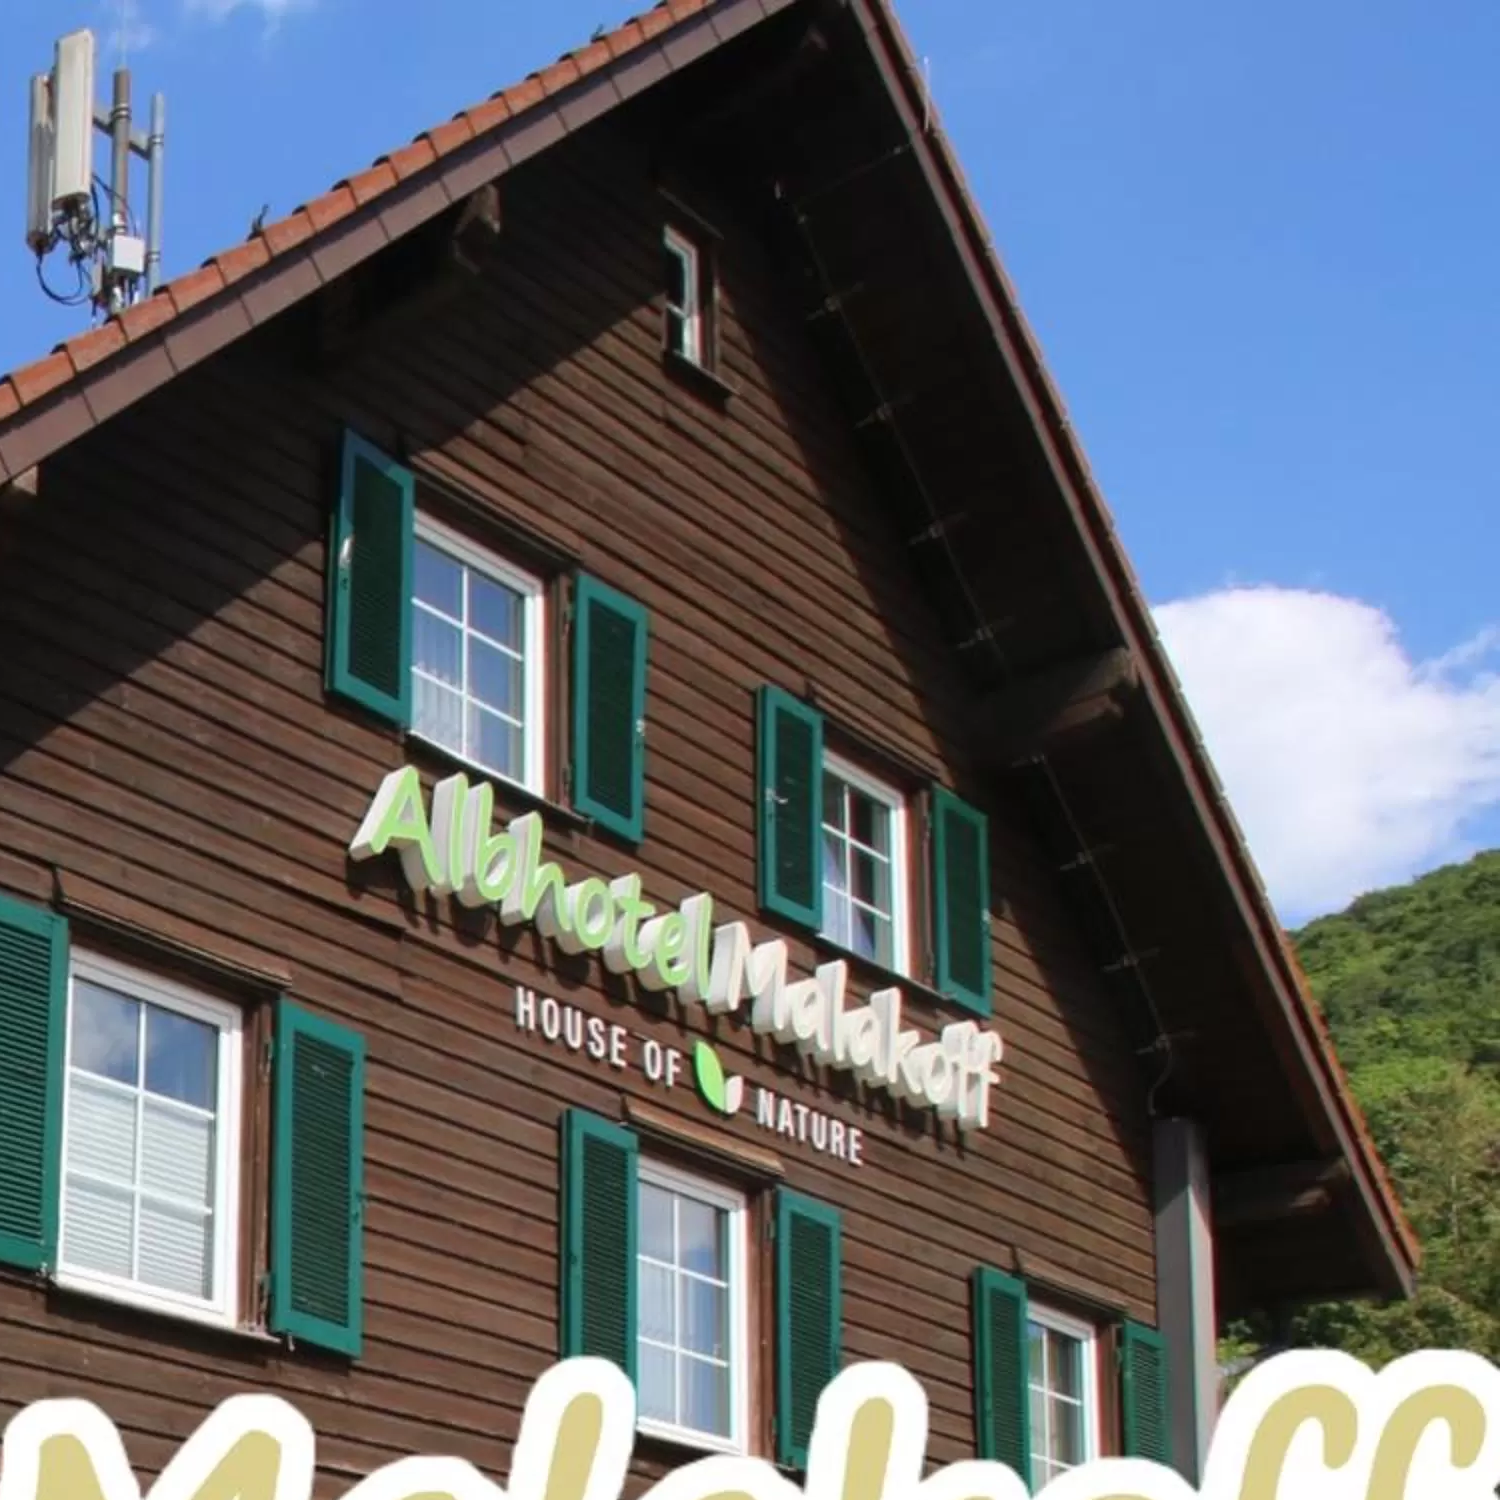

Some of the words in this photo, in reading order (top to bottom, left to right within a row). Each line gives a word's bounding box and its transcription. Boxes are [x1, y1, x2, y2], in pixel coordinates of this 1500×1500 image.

[350, 765, 713, 1004] Albhotel
[707, 921, 1003, 1130] Malakoff
[514, 986, 627, 1070] HOUSE
[644, 1040, 682, 1089] OF
[756, 1088, 864, 1166] NATURE
